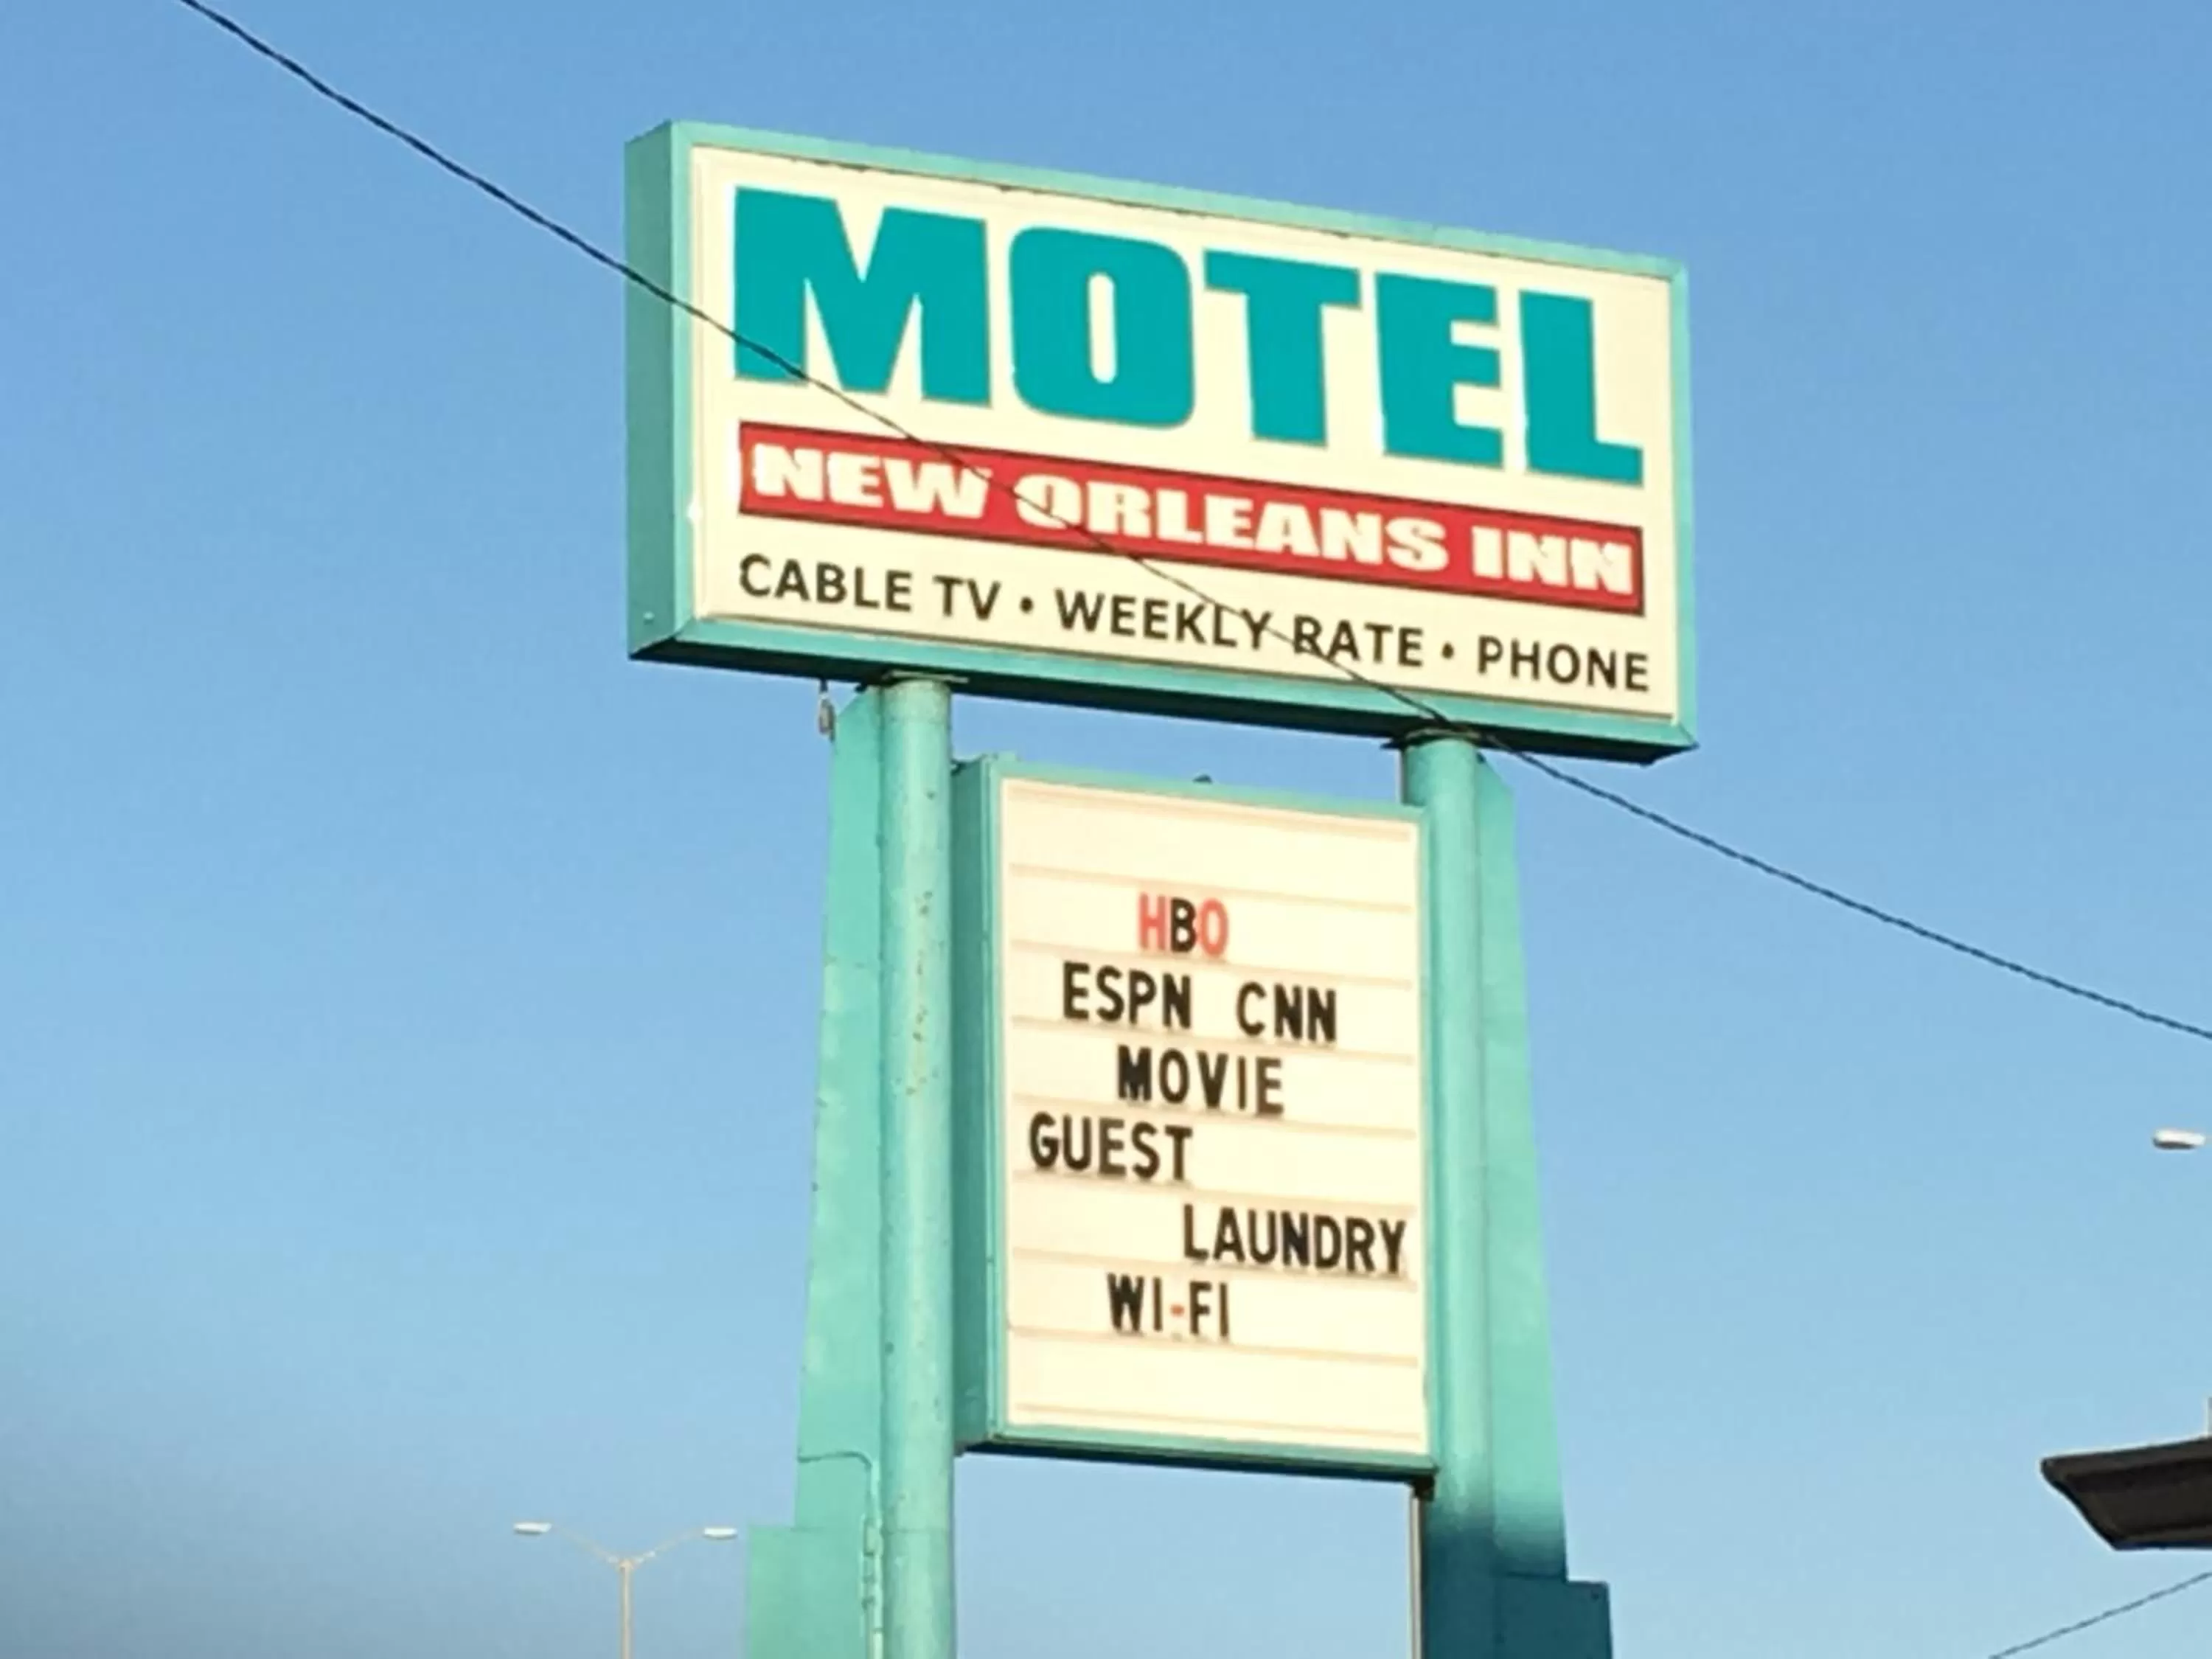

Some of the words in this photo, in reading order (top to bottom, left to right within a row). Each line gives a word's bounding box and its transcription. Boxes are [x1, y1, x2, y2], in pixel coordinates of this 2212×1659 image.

[734, 187, 1644, 487] MOTEL
[752, 442, 993, 519] NEW
[1016, 473, 1448, 572] ORLEANS
[1472, 526, 1633, 594] INN
[739, 553, 912, 612] CABLE
[933, 576, 1001, 621] TV
[1054, 589, 1273, 650] WEEKLY
[1294, 615, 1424, 667] RATE
[1478, 636, 1649, 692] PHONE
[1138, 893, 1229, 956] HBO
[1062, 961, 1192, 1029] ESPN
[1237, 982, 1337, 1043] CNN
[1117, 1046, 1284, 1116] MOVIE
[1029, 1112, 1192, 1181] GUEST
[1183, 1204, 1407, 1273] LAUNDRY
[1107, 1273, 1231, 1337] WI-FI
